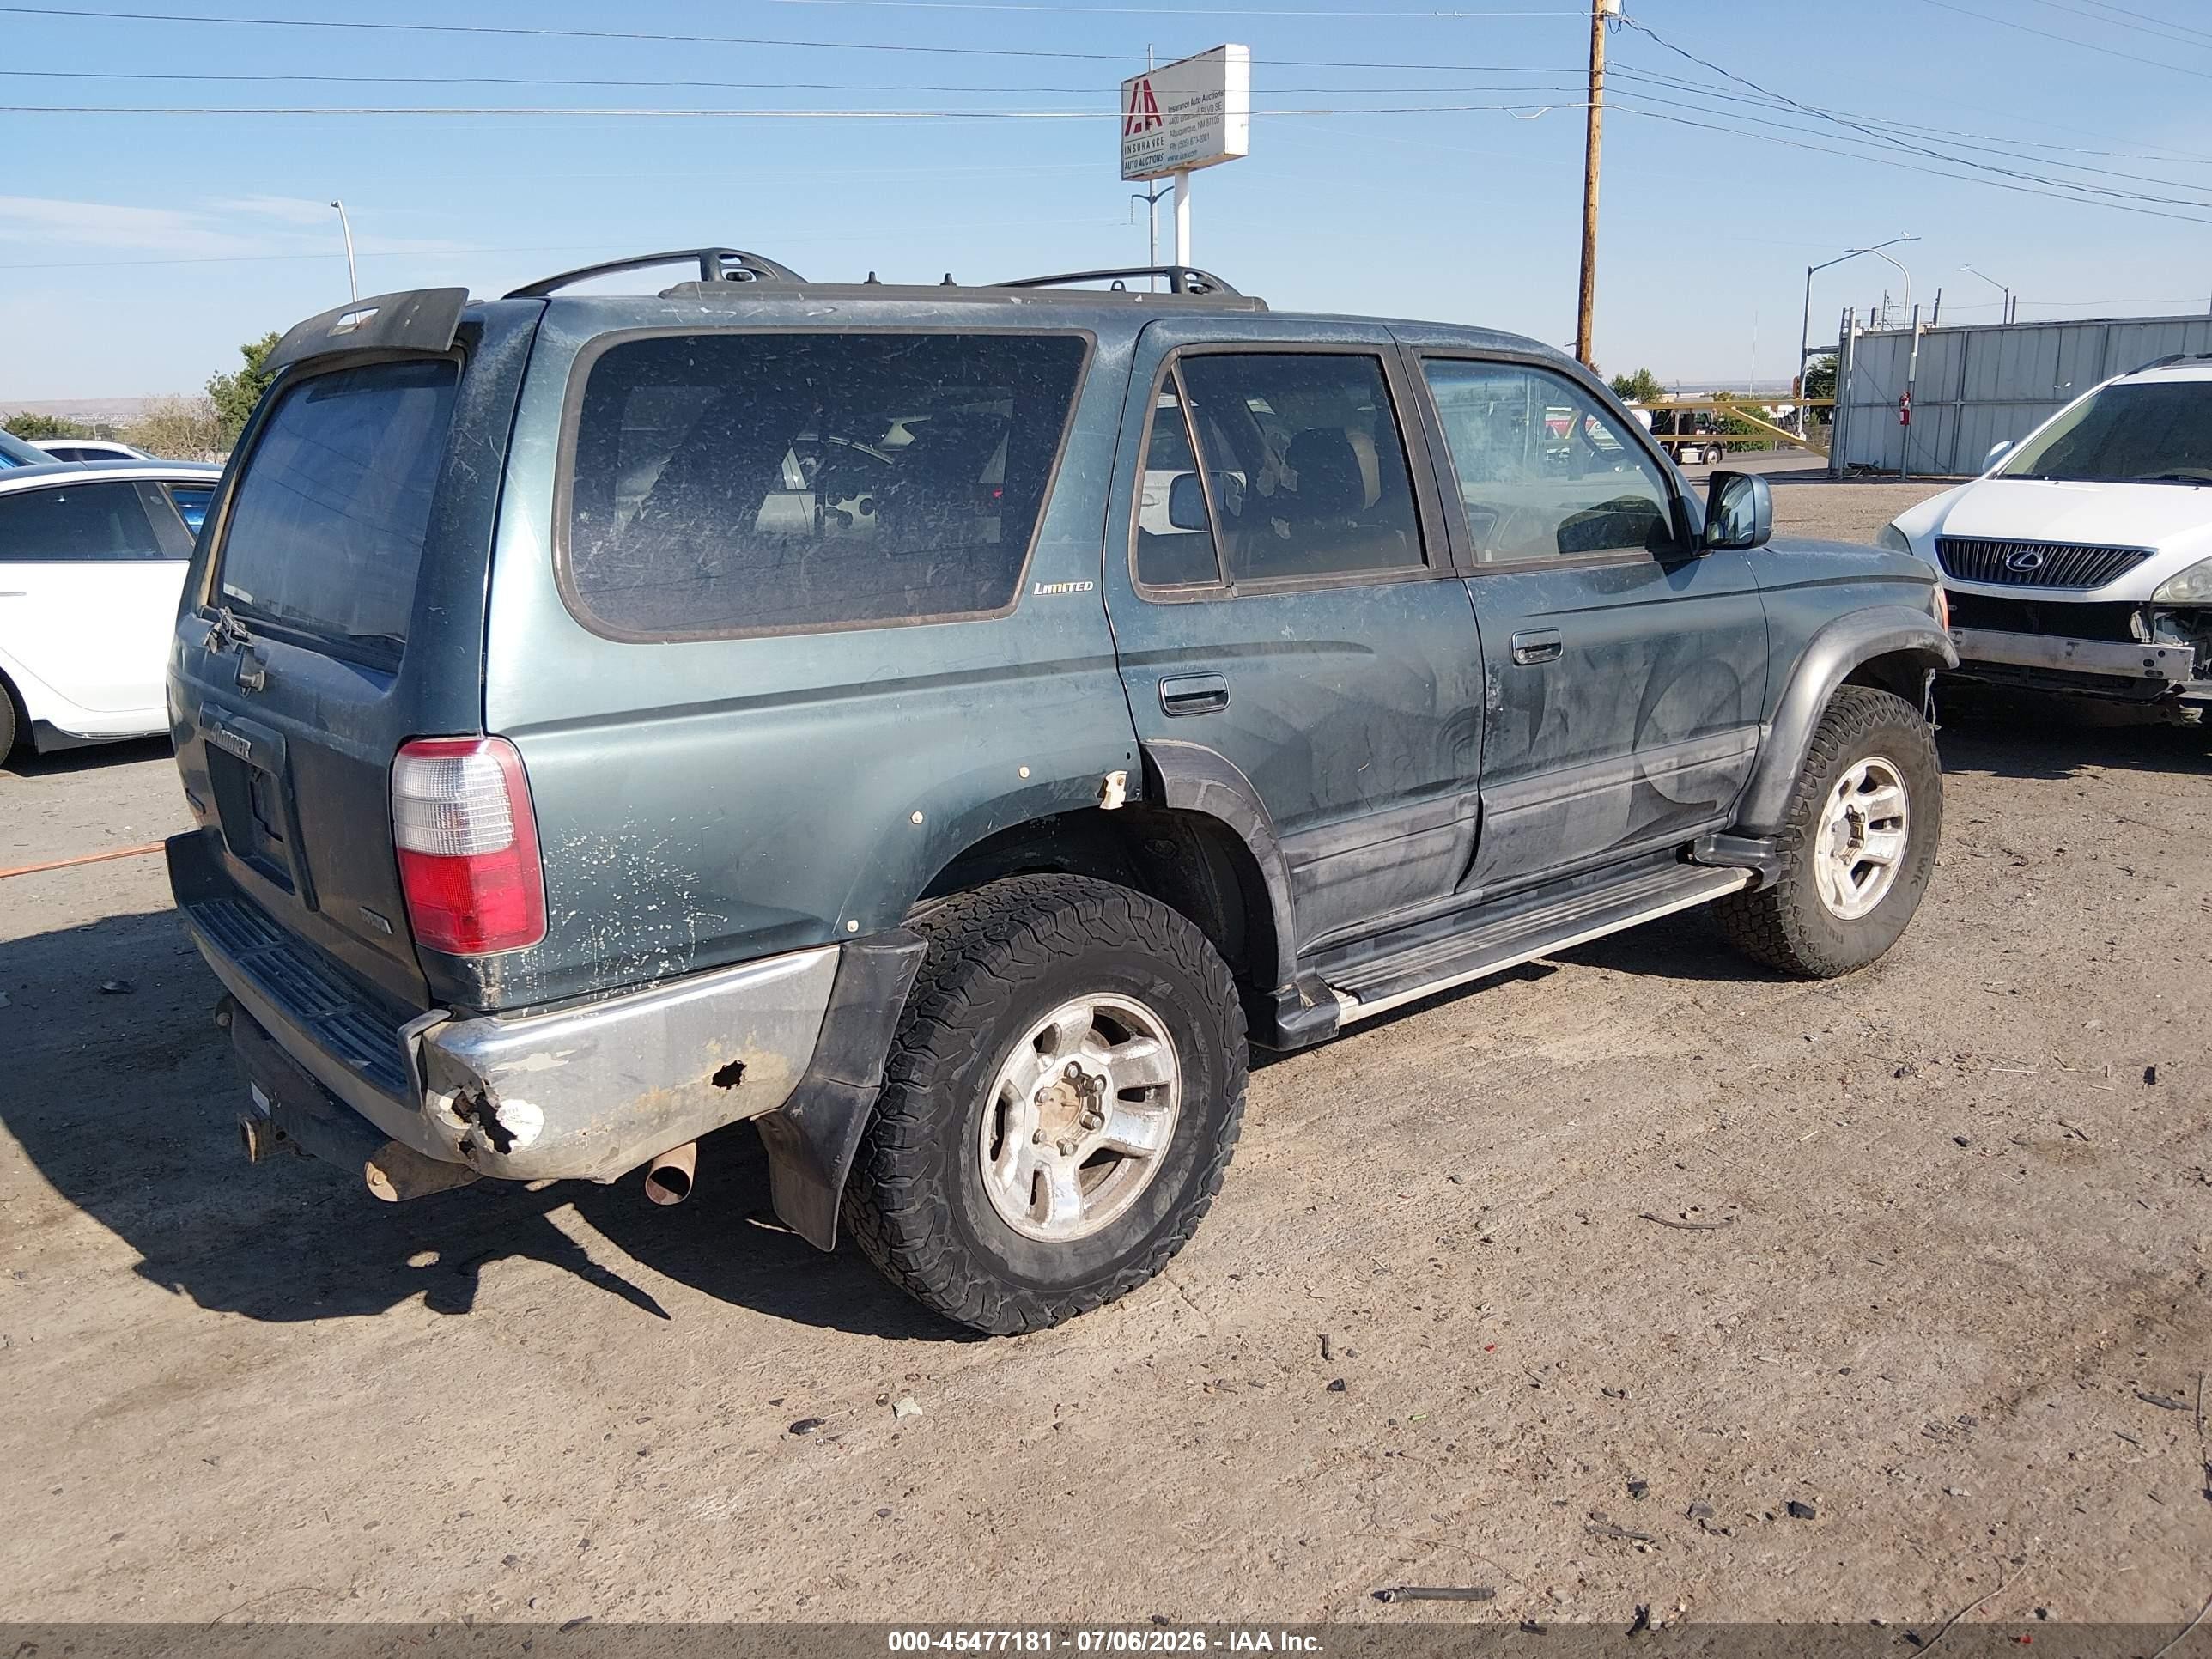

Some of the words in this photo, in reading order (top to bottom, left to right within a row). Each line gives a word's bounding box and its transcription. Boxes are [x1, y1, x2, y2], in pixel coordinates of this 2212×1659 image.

[1168, 100, 1190, 113] Insurance
[1191, 96, 1201, 106] Auto
[1202, 90, 1224, 103] Auctions
[1215, 101, 1222, 112] SE
[1124, 137, 1164, 155] INSURANCE
[1124, 159, 1139, 170] AUTO
[1033, 581, 1094, 595] LIMITED
